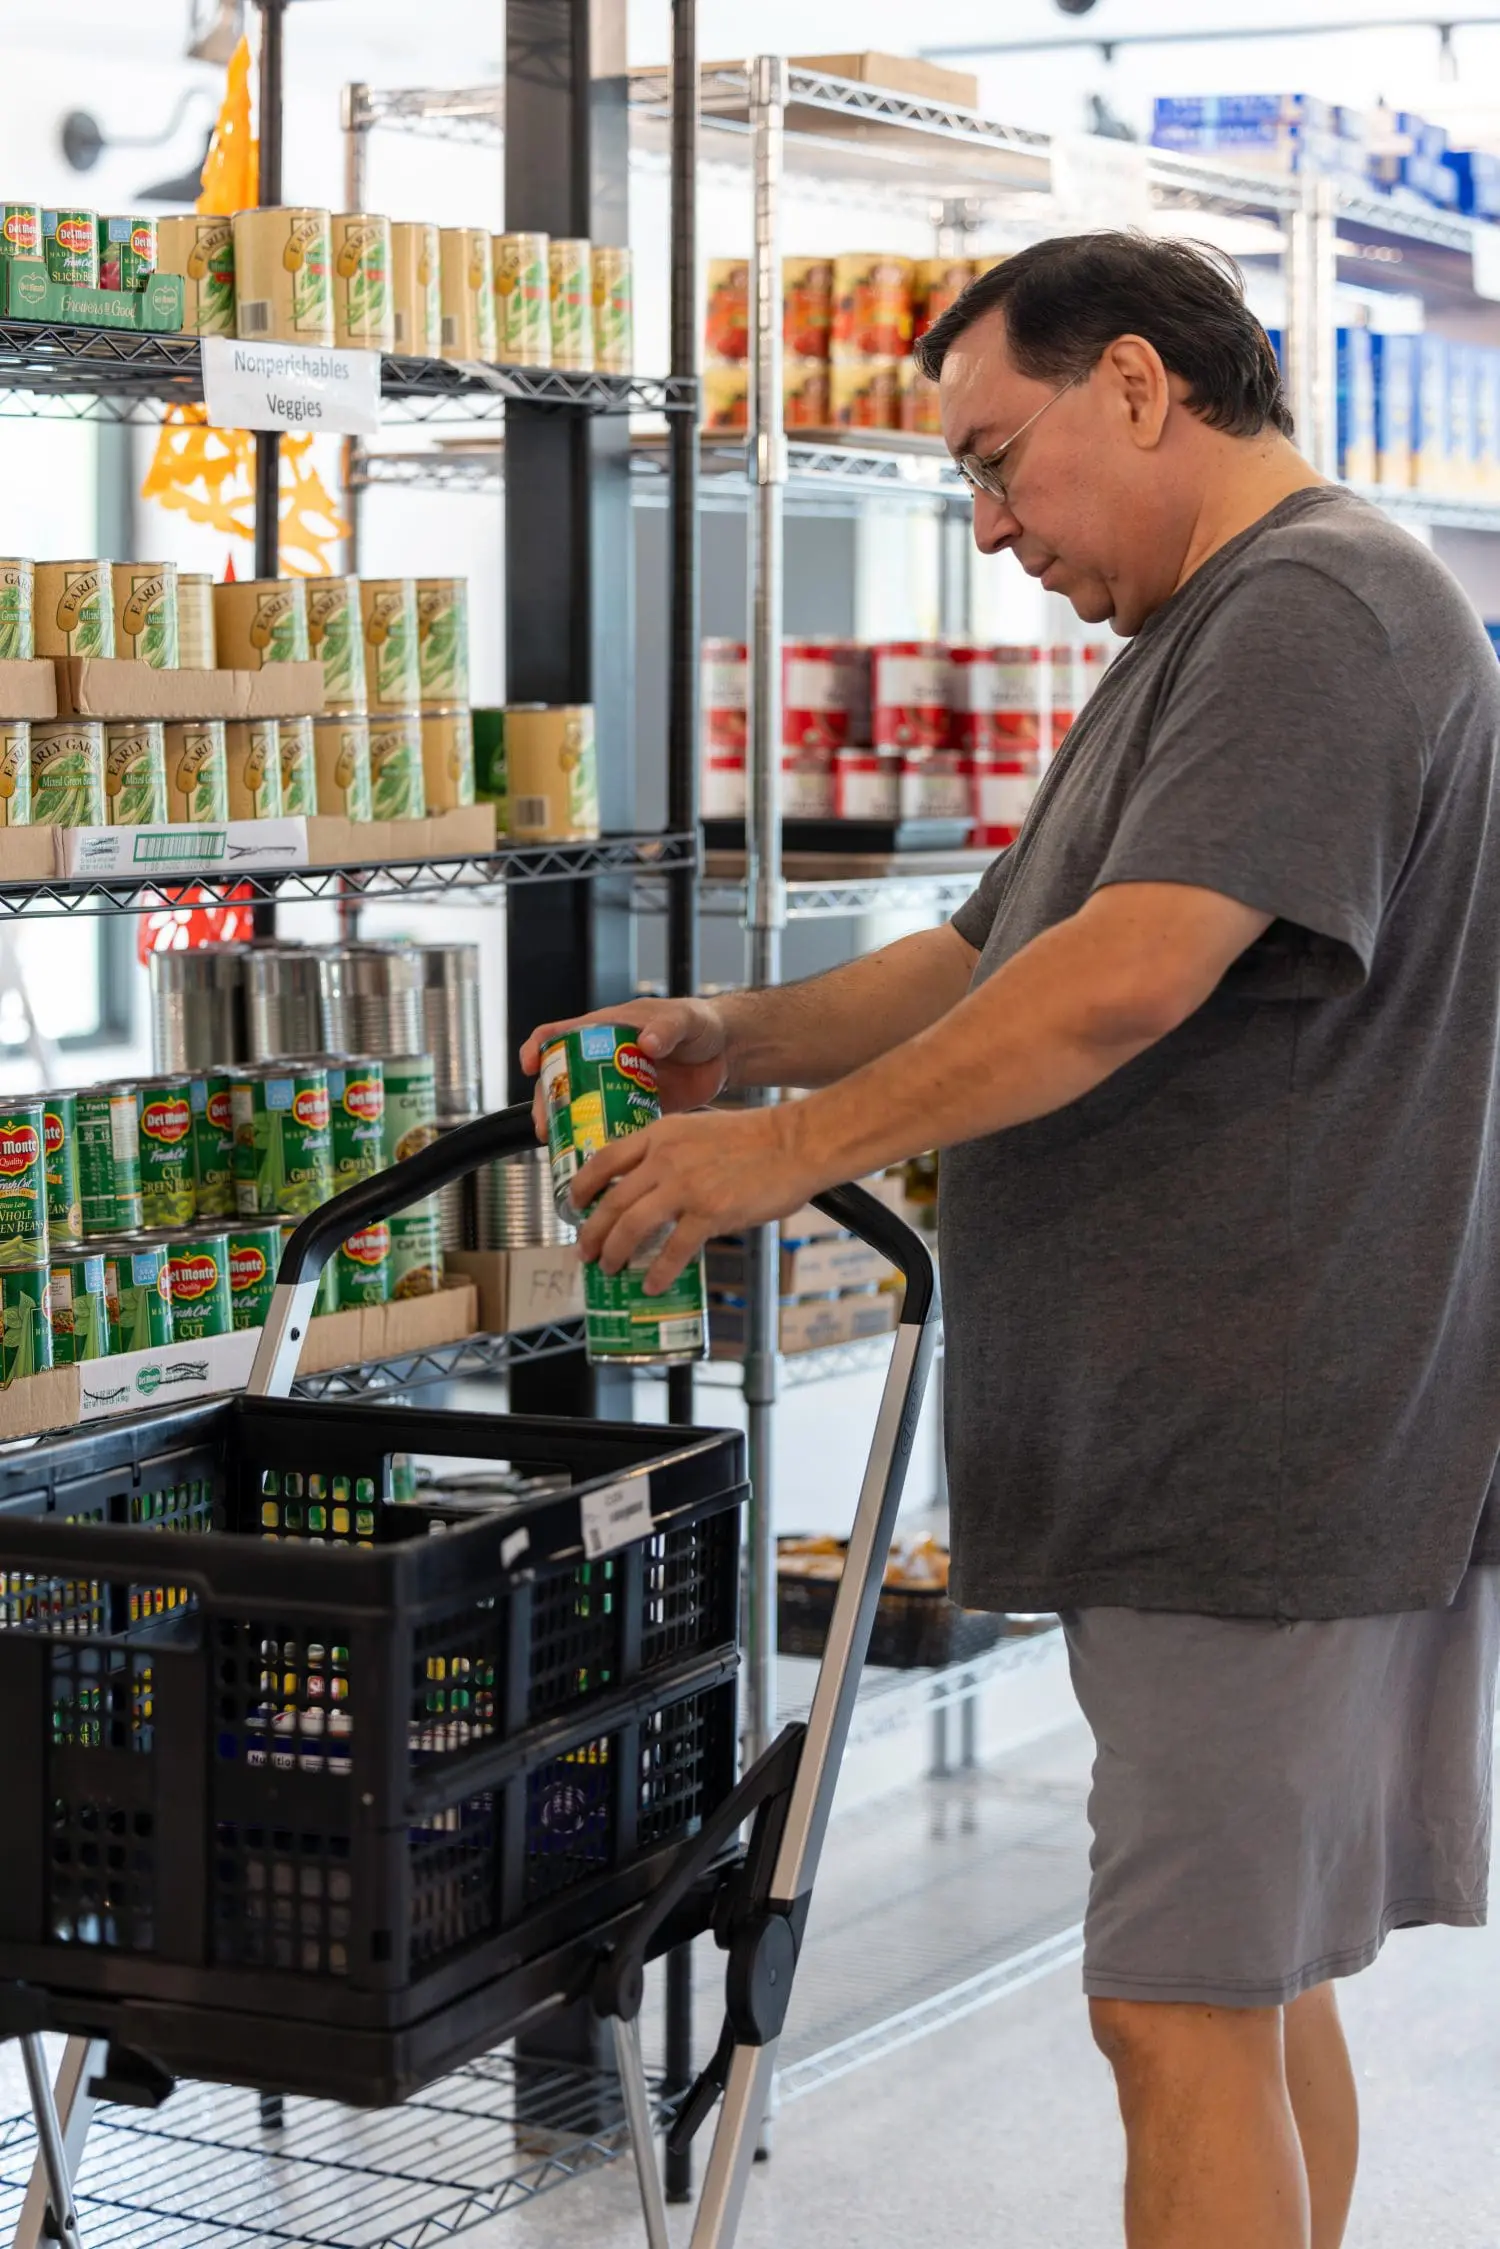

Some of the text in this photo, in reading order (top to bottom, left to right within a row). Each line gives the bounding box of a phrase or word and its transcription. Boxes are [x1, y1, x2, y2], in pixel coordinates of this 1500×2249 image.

[61, 229, 93, 242] Del Mont
[52, 271, 82, 284] SLICED
[61, 294, 104, 316] Growers
[111, 300, 137, 319] Good
[235, 350, 350, 380] Nonperishables
[266, 394, 323, 422] Veggies
[64, 573, 99, 613] EARLY
[130, 579, 164, 617] EARLY
[107, 738, 144, 779] EARLY
[42, 776, 63, 788] Mixed
[64, 775, 83, 787] Green
[125, 774, 143, 786] Mixed
[620, 1052, 638, 1067] Del
[606, 1083, 636, 1092] MADE
[348, 1092, 365, 1105] Del
[86, 1102, 109, 1112] Facts
[211, 1104, 228, 1117] Del
[147, 1114, 165, 1128] Del
[45, 1126, 61, 1140] nte
[3, 1140, 37, 1156] Monte
[161, 1165, 182, 1181] CUT
[48, 1203, 69, 1216] EANS
[17, 1219, 44, 1232] BEANS
[230, 1258, 262, 1273] Monte
[137, 1273, 156, 1282] SALT
[180, 1267, 215, 1283] Monte
[176, 1282, 202, 1293] Quality
[250, 1286, 275, 1296] WITH
[233, 1313, 252, 1327] UT
[179, 1323, 205, 1338] CUT
